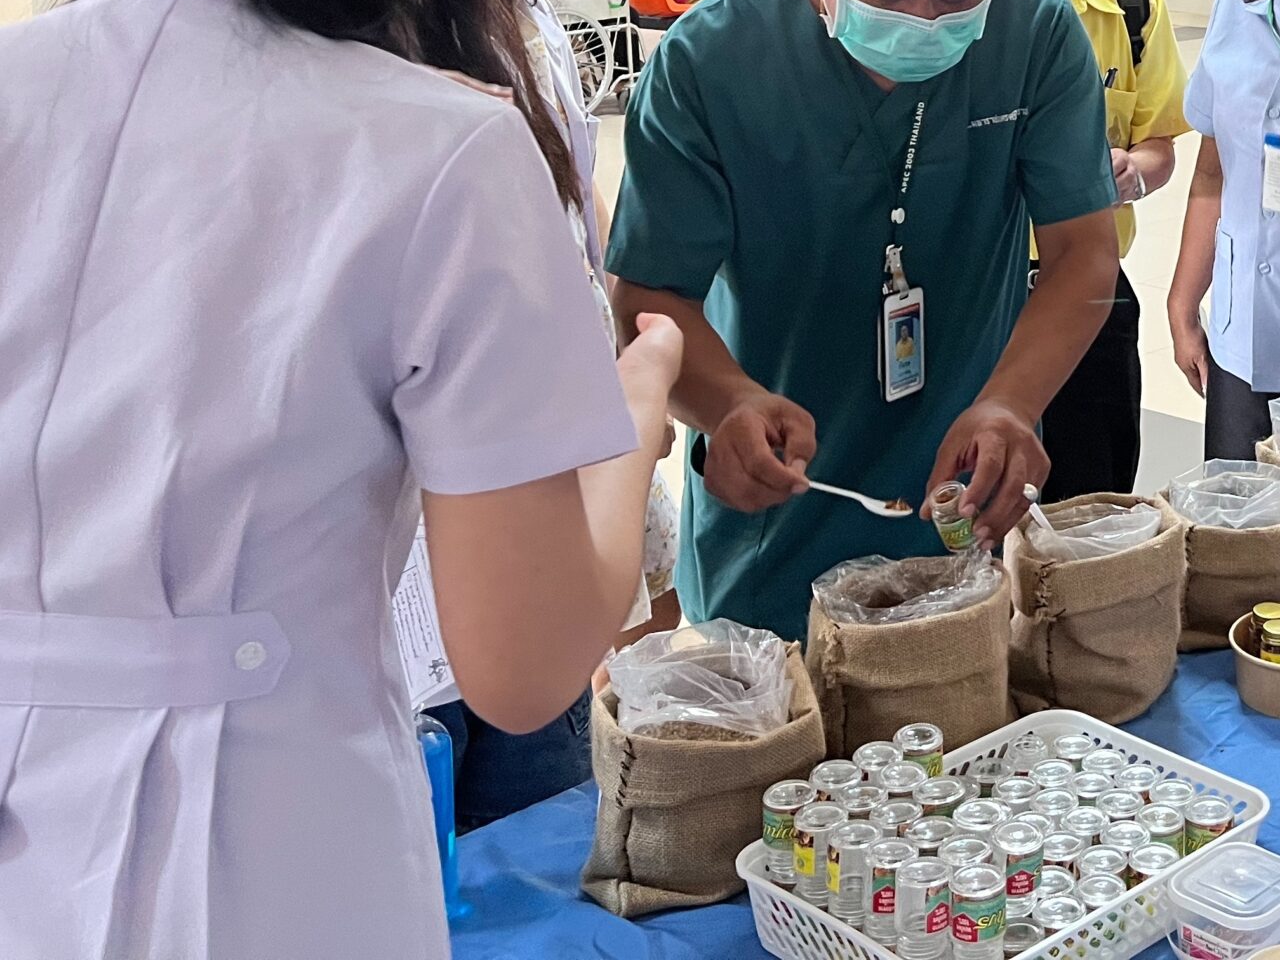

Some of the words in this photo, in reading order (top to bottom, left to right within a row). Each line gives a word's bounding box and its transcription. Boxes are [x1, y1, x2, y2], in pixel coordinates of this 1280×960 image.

[909, 102, 925, 146] THAILAND
[905, 148, 915, 170] 2003
[901, 171, 911, 194] APEC
